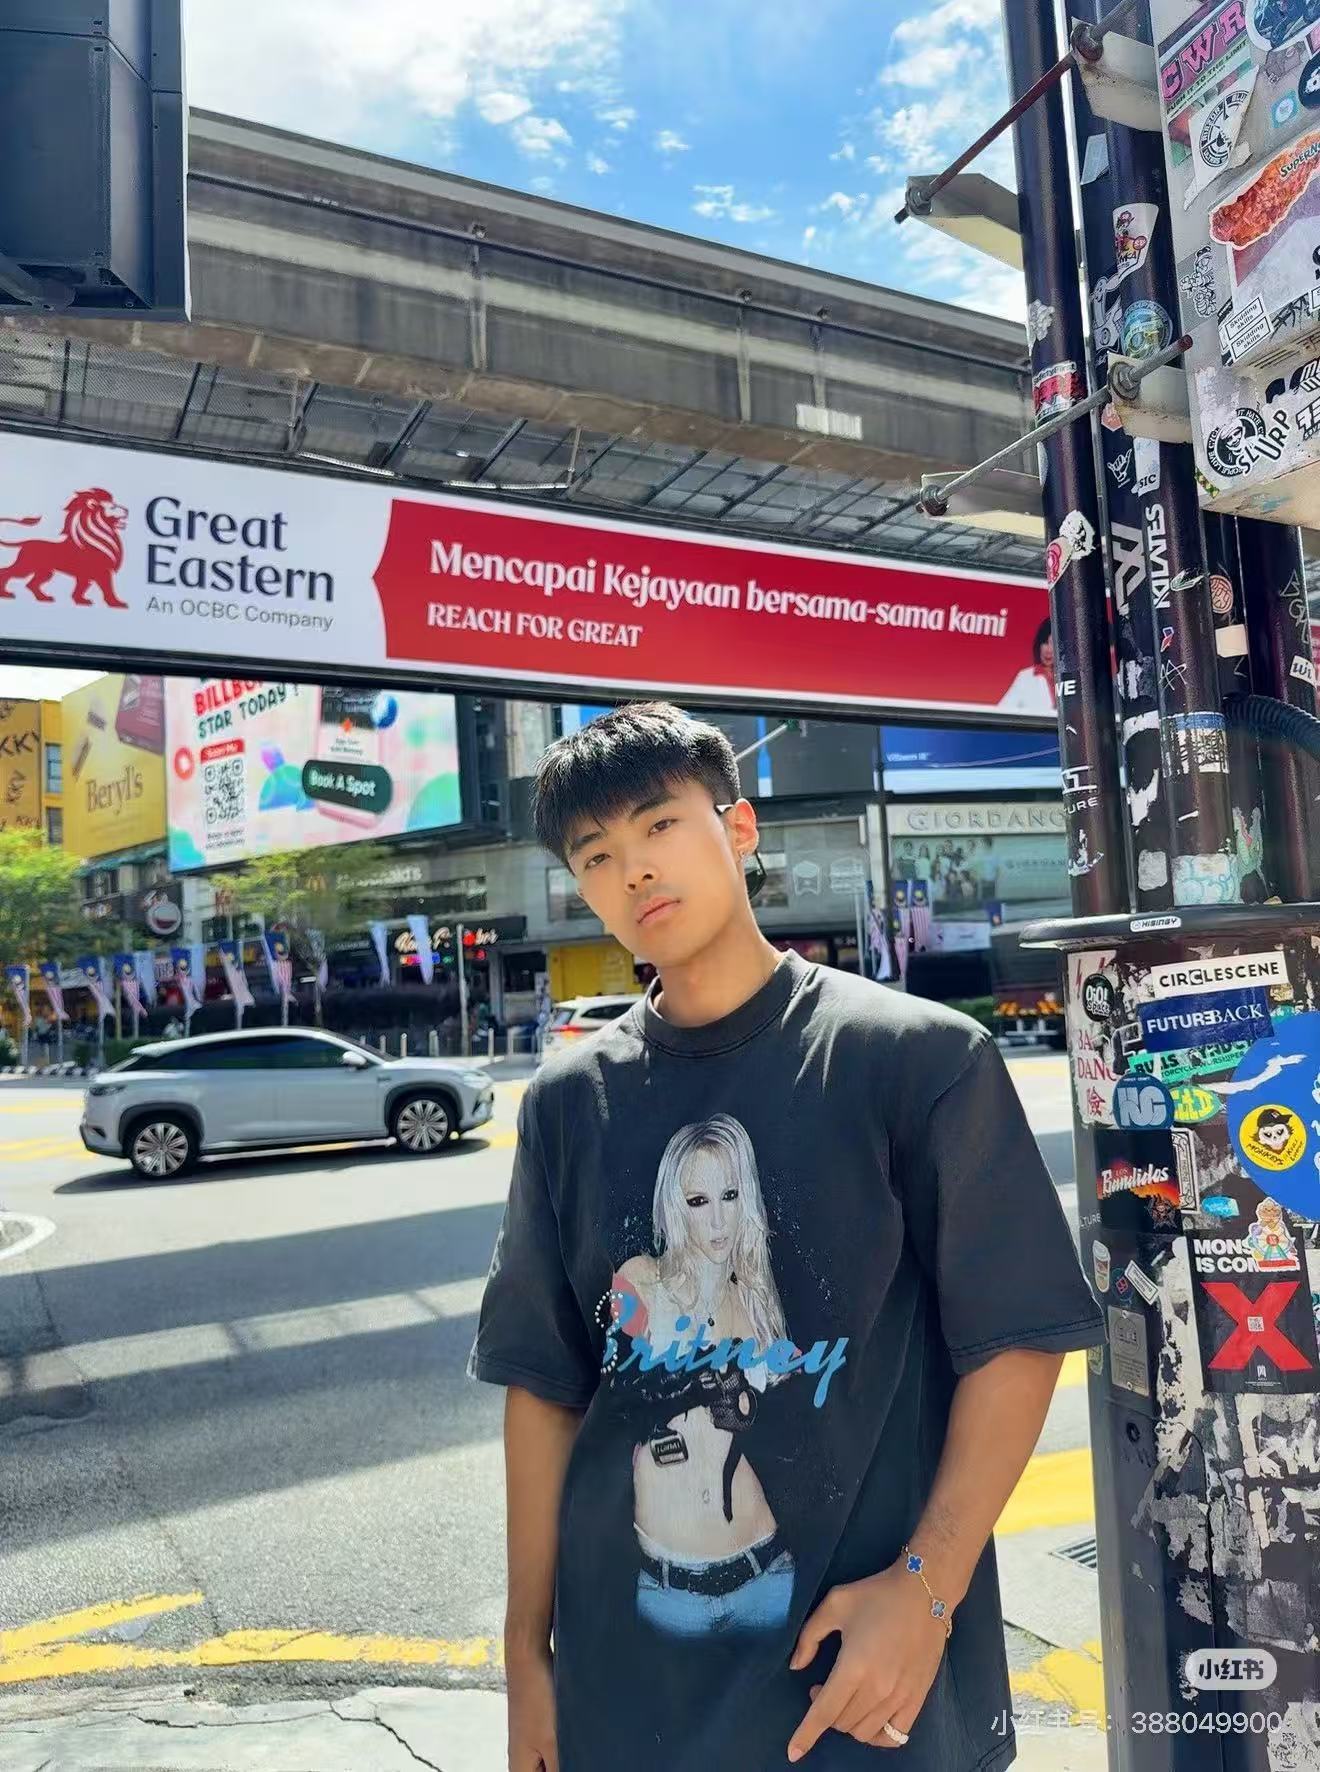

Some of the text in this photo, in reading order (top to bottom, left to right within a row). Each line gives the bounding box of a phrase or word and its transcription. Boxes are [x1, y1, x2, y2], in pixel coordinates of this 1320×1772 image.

[1160, 1, 1247, 99] CWR
[1238, 409, 1291, 475] SLURP
[146, 496, 288, 551] Great
[147, 545, 335, 602] Eastern
[428, 538, 1008, 638] Mencapai Kejayaan bersama-sama kami
[147, 597, 335, 633] An OCBC Company
[426, 603, 643, 649] REACH FOR GREAT
[198, 709, 233, 739] STAR
[239, 682, 288, 721] TODAY
[85, 764, 144, 817] Beryl's
[309, 768, 376, 798] Book A Spot
[1101, 1163, 1169, 1196] Bandidos
[1193, 1238, 1253, 1256] MONS
[1195, 1256, 1215, 1273] IS
